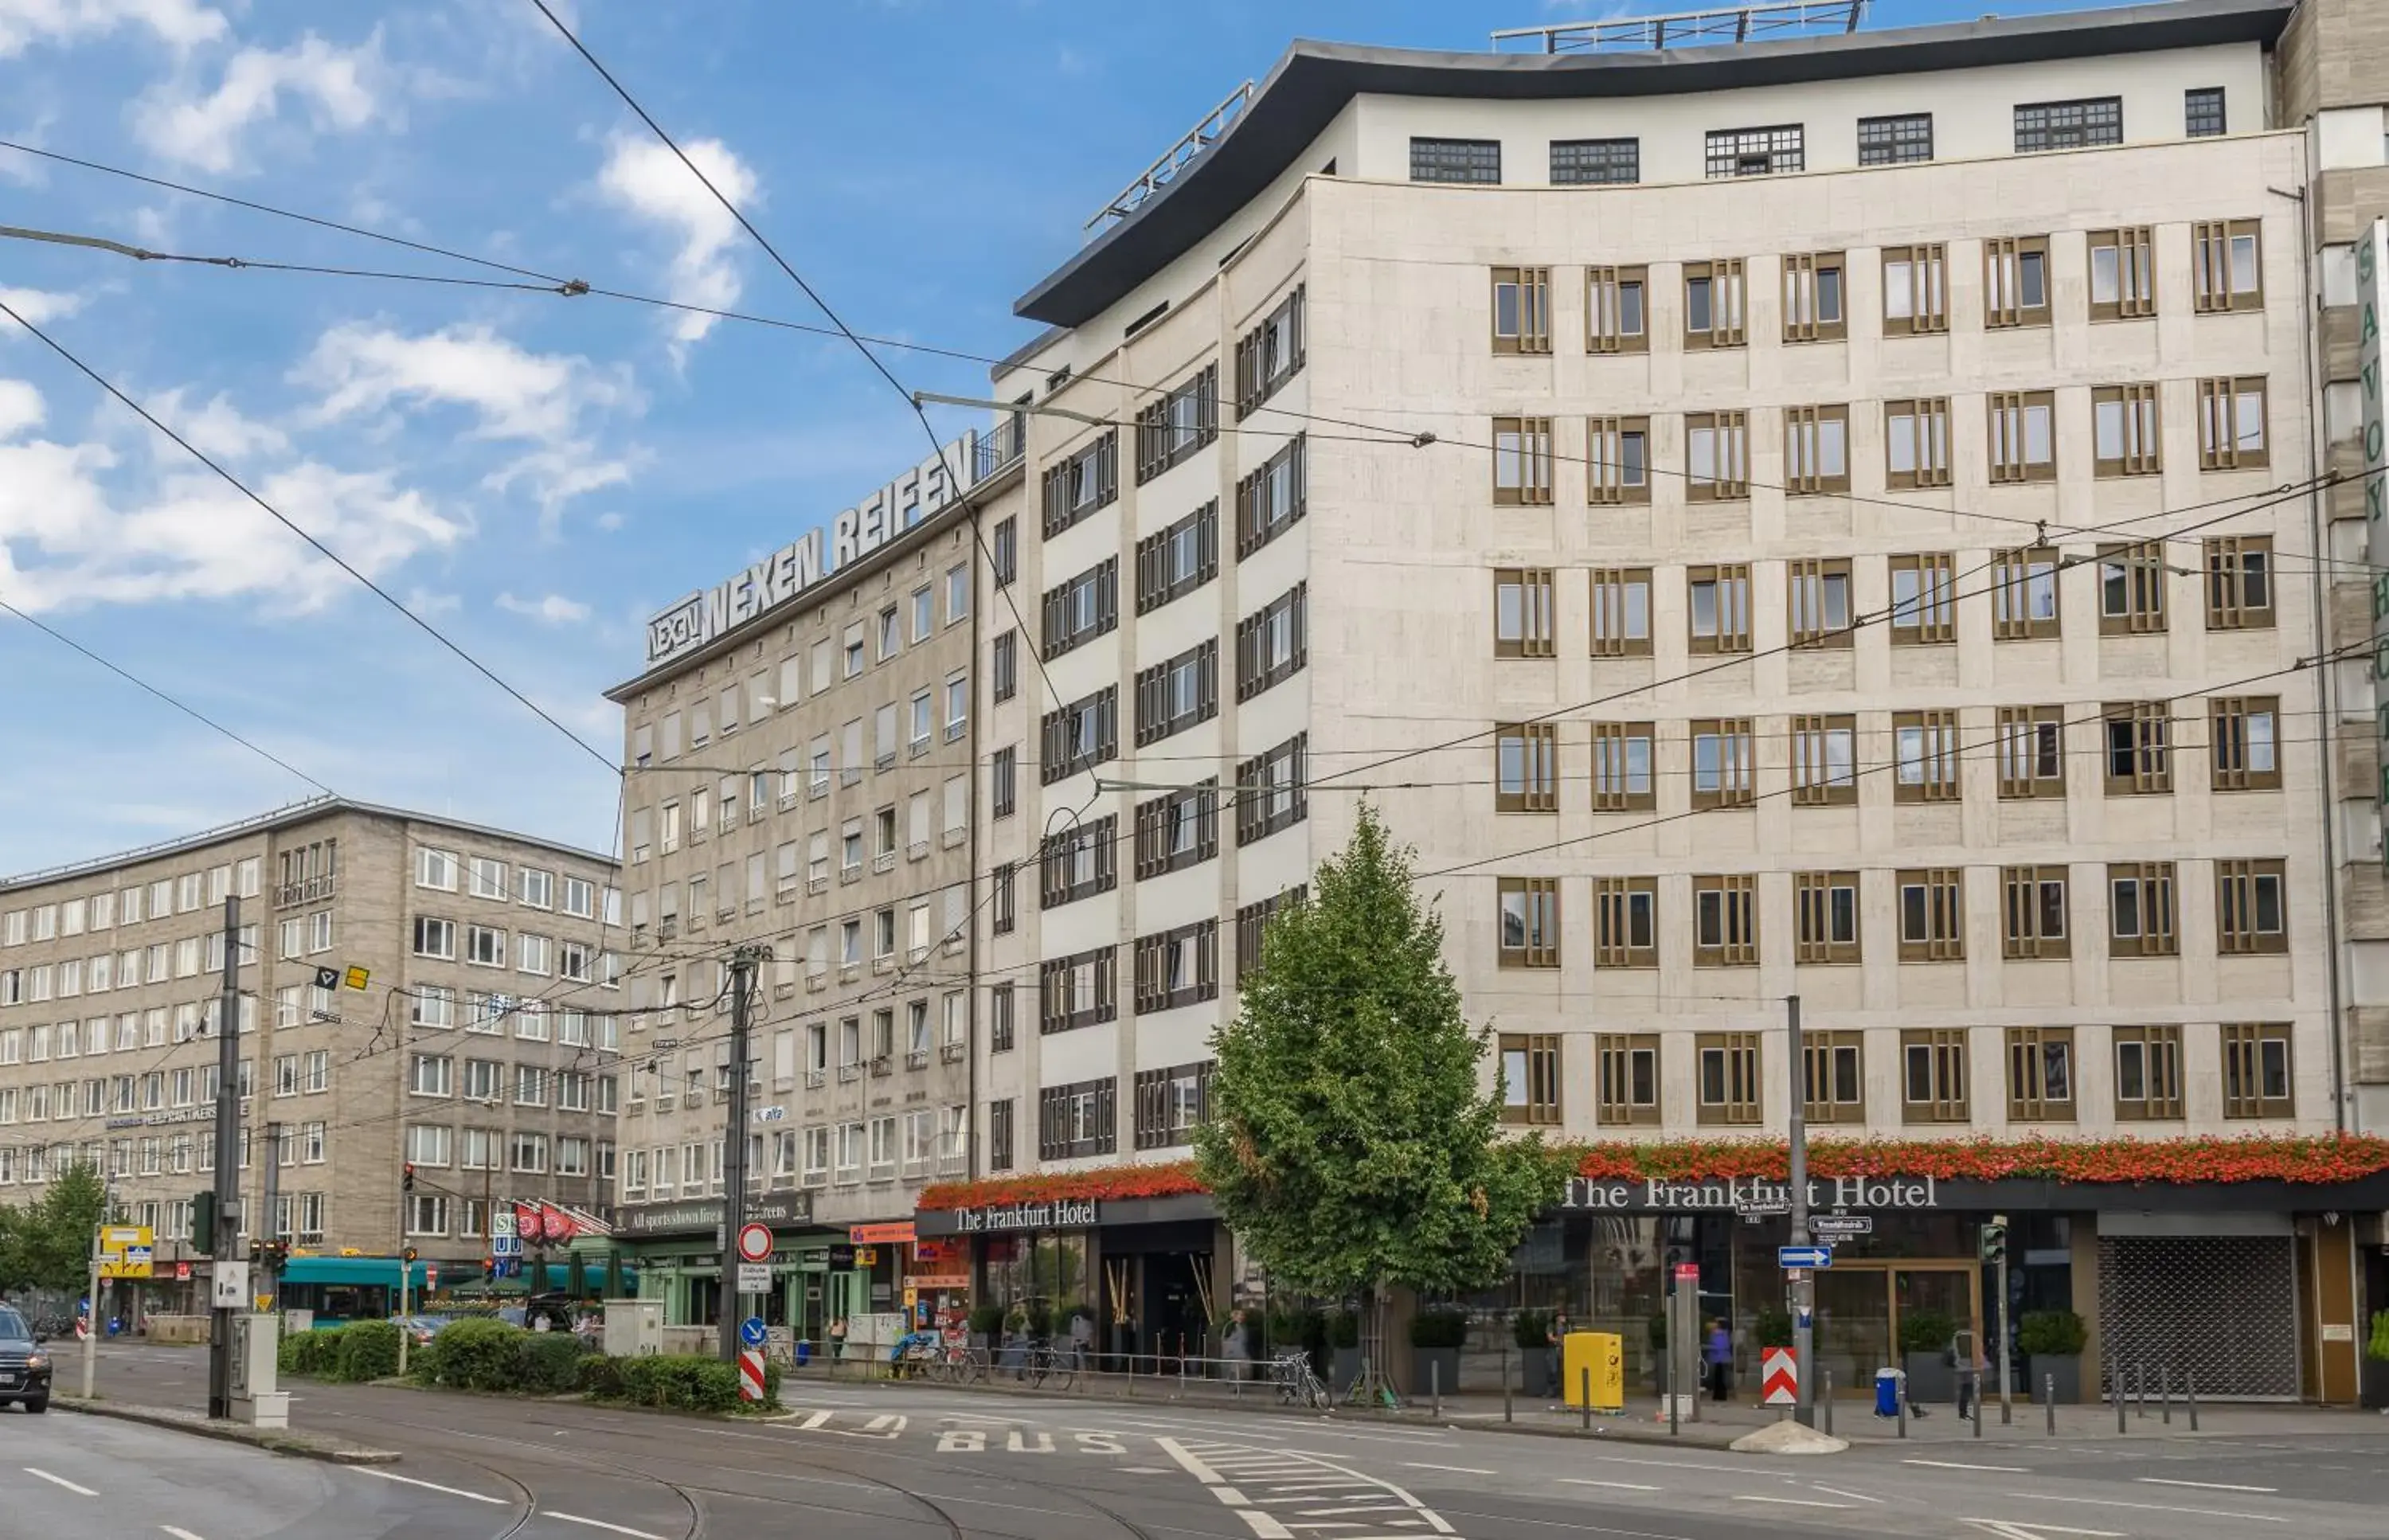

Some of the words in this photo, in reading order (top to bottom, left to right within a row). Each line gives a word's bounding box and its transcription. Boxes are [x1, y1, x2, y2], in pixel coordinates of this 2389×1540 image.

[2359, 240, 2383, 522] SAVOY
[702, 526, 823, 645] NEXEN
[832, 428, 978, 570] REIFEN
[647, 601, 700, 662] NEXEN
[1562, 1176, 1629, 1208] The
[1644, 1175, 1820, 1208] Frankfut
[1832, 1175, 1937, 1207] Hotel
[631, 1211, 645, 1228] All
[700, 1206, 717, 1223] live
[955, 1206, 982, 1231] The
[984, 1201, 1050, 1230] Frankfurt
[1054, 1197, 1097, 1225] Hotel
[498, 1237, 507, 1251] U
[511, 1237, 521, 1251] U
[936, 1431, 1128, 1453] BUS
